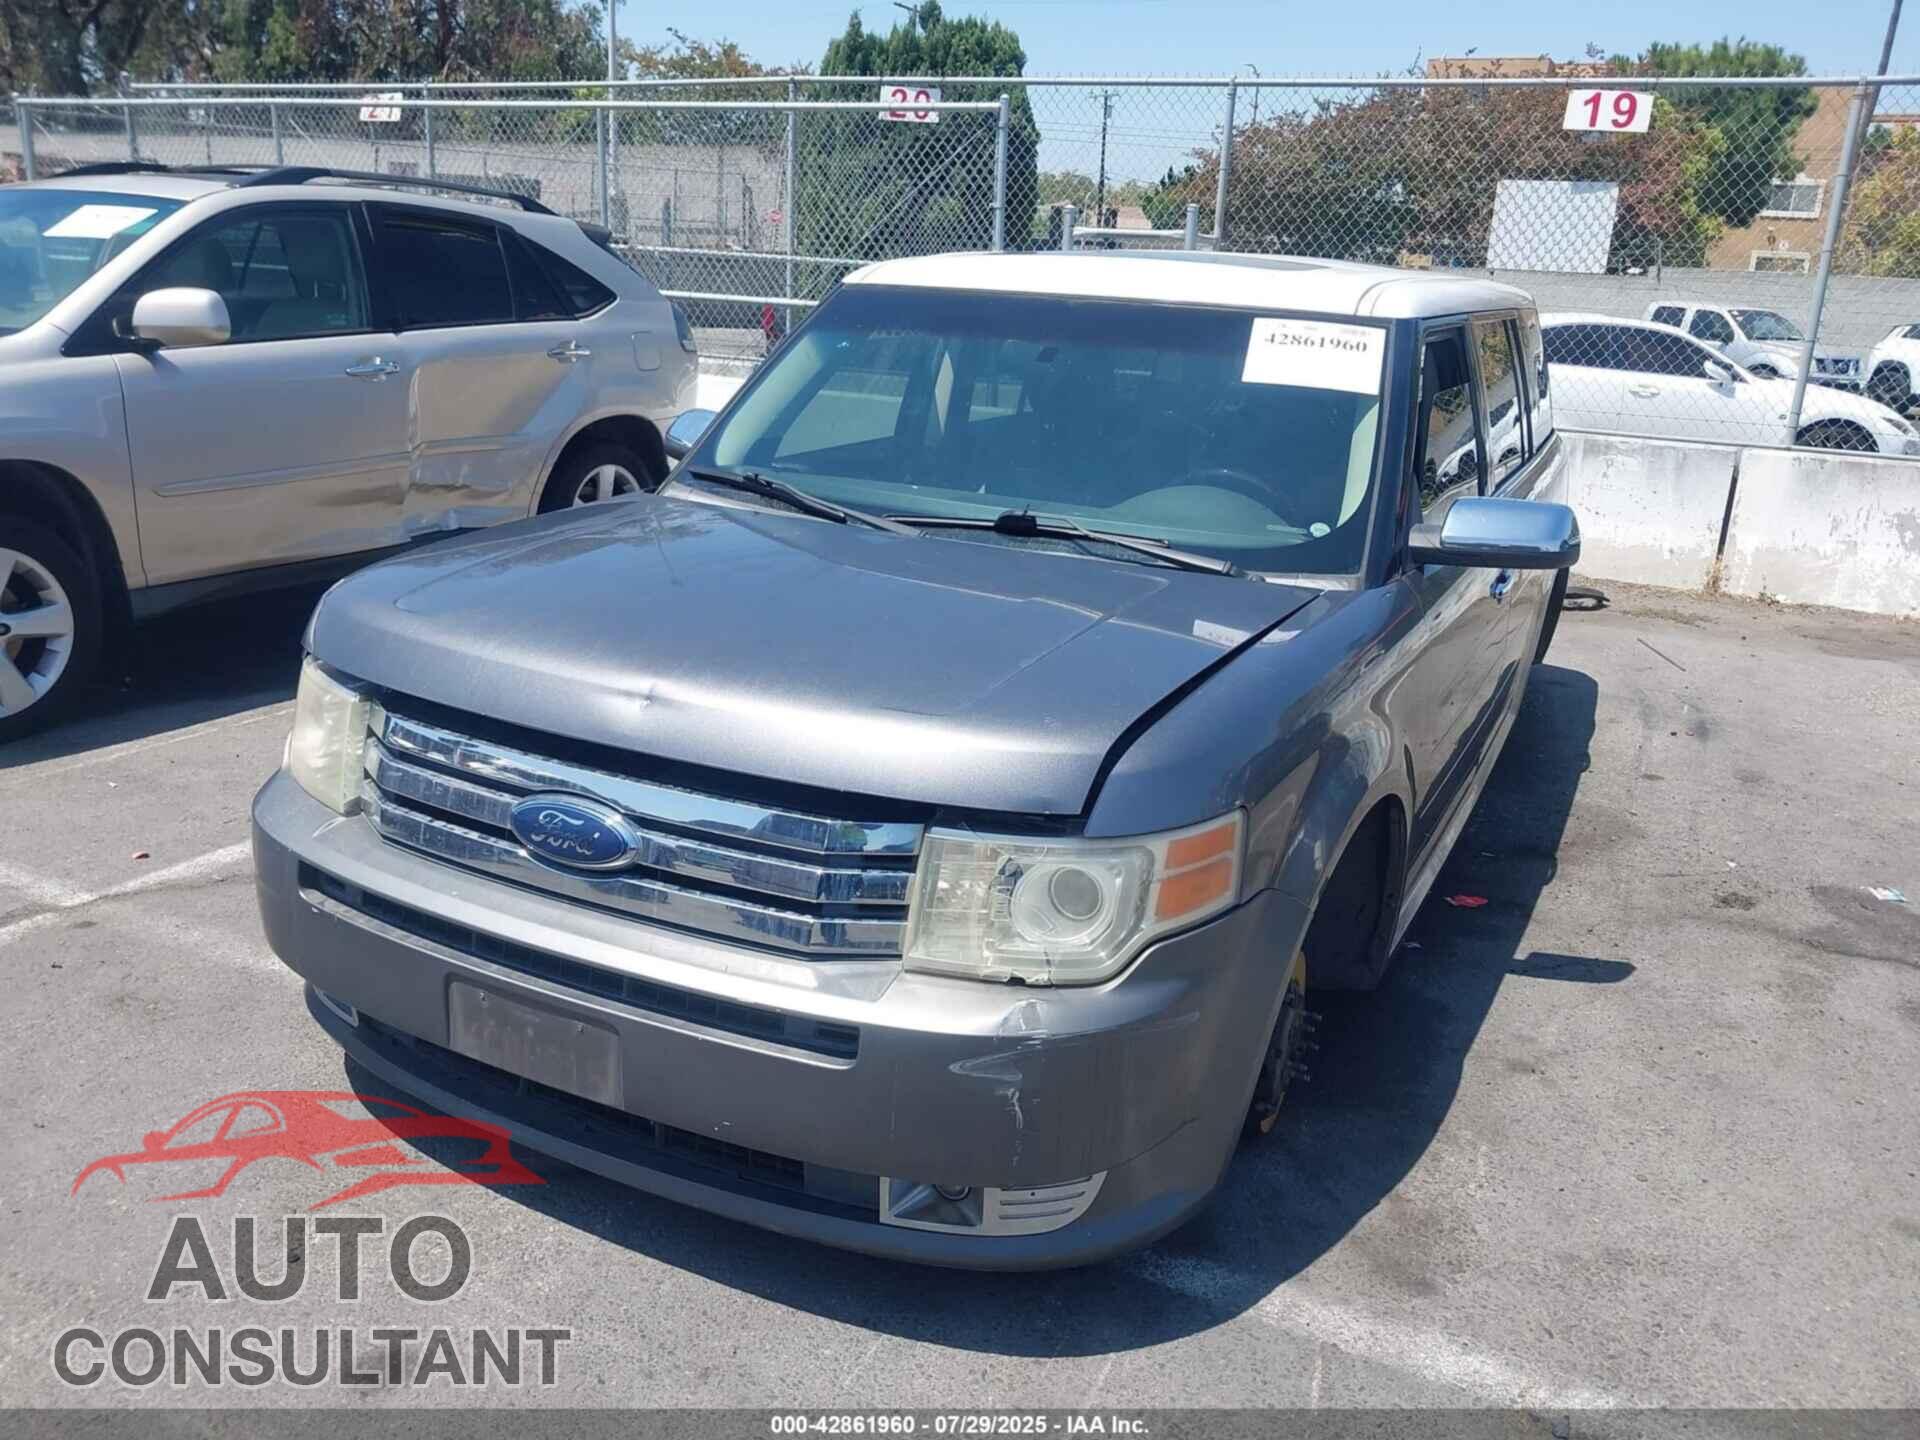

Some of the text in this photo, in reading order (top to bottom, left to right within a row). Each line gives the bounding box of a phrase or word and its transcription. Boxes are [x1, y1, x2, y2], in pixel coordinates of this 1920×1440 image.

[889, 88, 931, 120] 20
[1583, 91, 1638, 129] 19
[1264, 332, 1368, 353] 42861960
[530, 809, 601, 856] Ford
